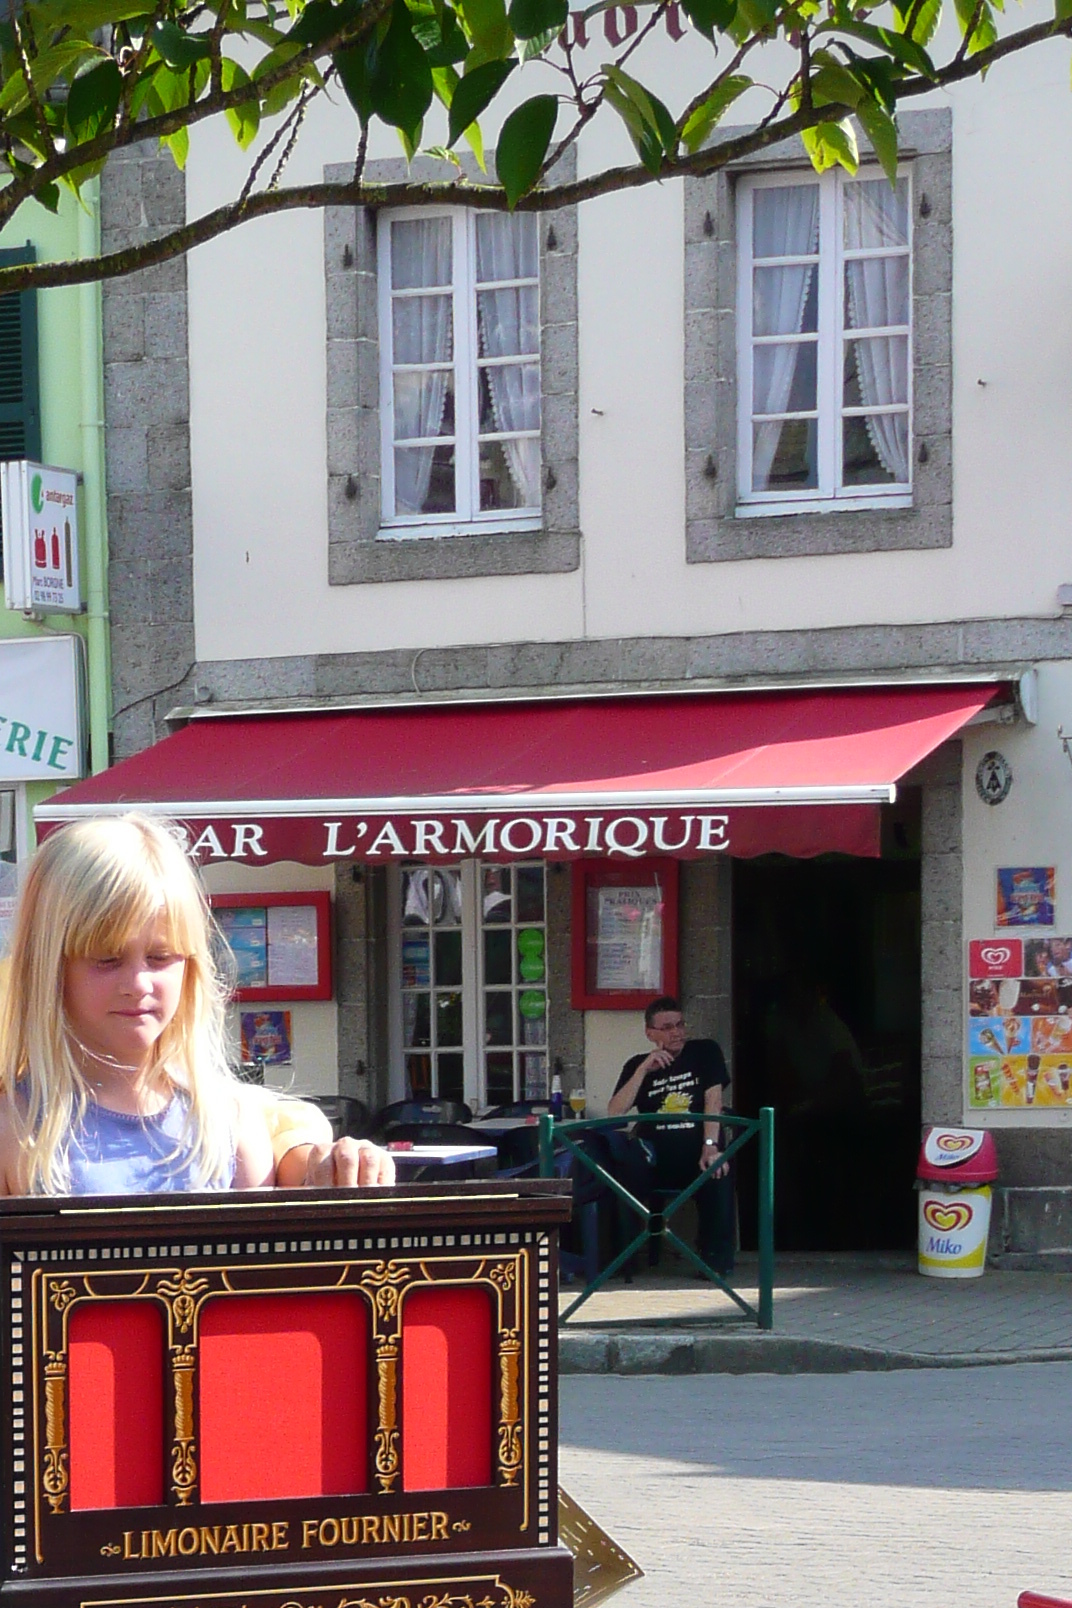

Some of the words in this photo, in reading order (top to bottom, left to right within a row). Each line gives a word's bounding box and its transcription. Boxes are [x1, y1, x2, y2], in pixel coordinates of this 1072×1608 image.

[168, 823, 269, 858] BAR
[322, 814, 730, 858] L'ARMORIQUE
[926, 1237, 962, 1255] Miko
[122, 1521, 290, 1561] LIMONAIRE
[301, 1510, 450, 1549] FOURNIER
